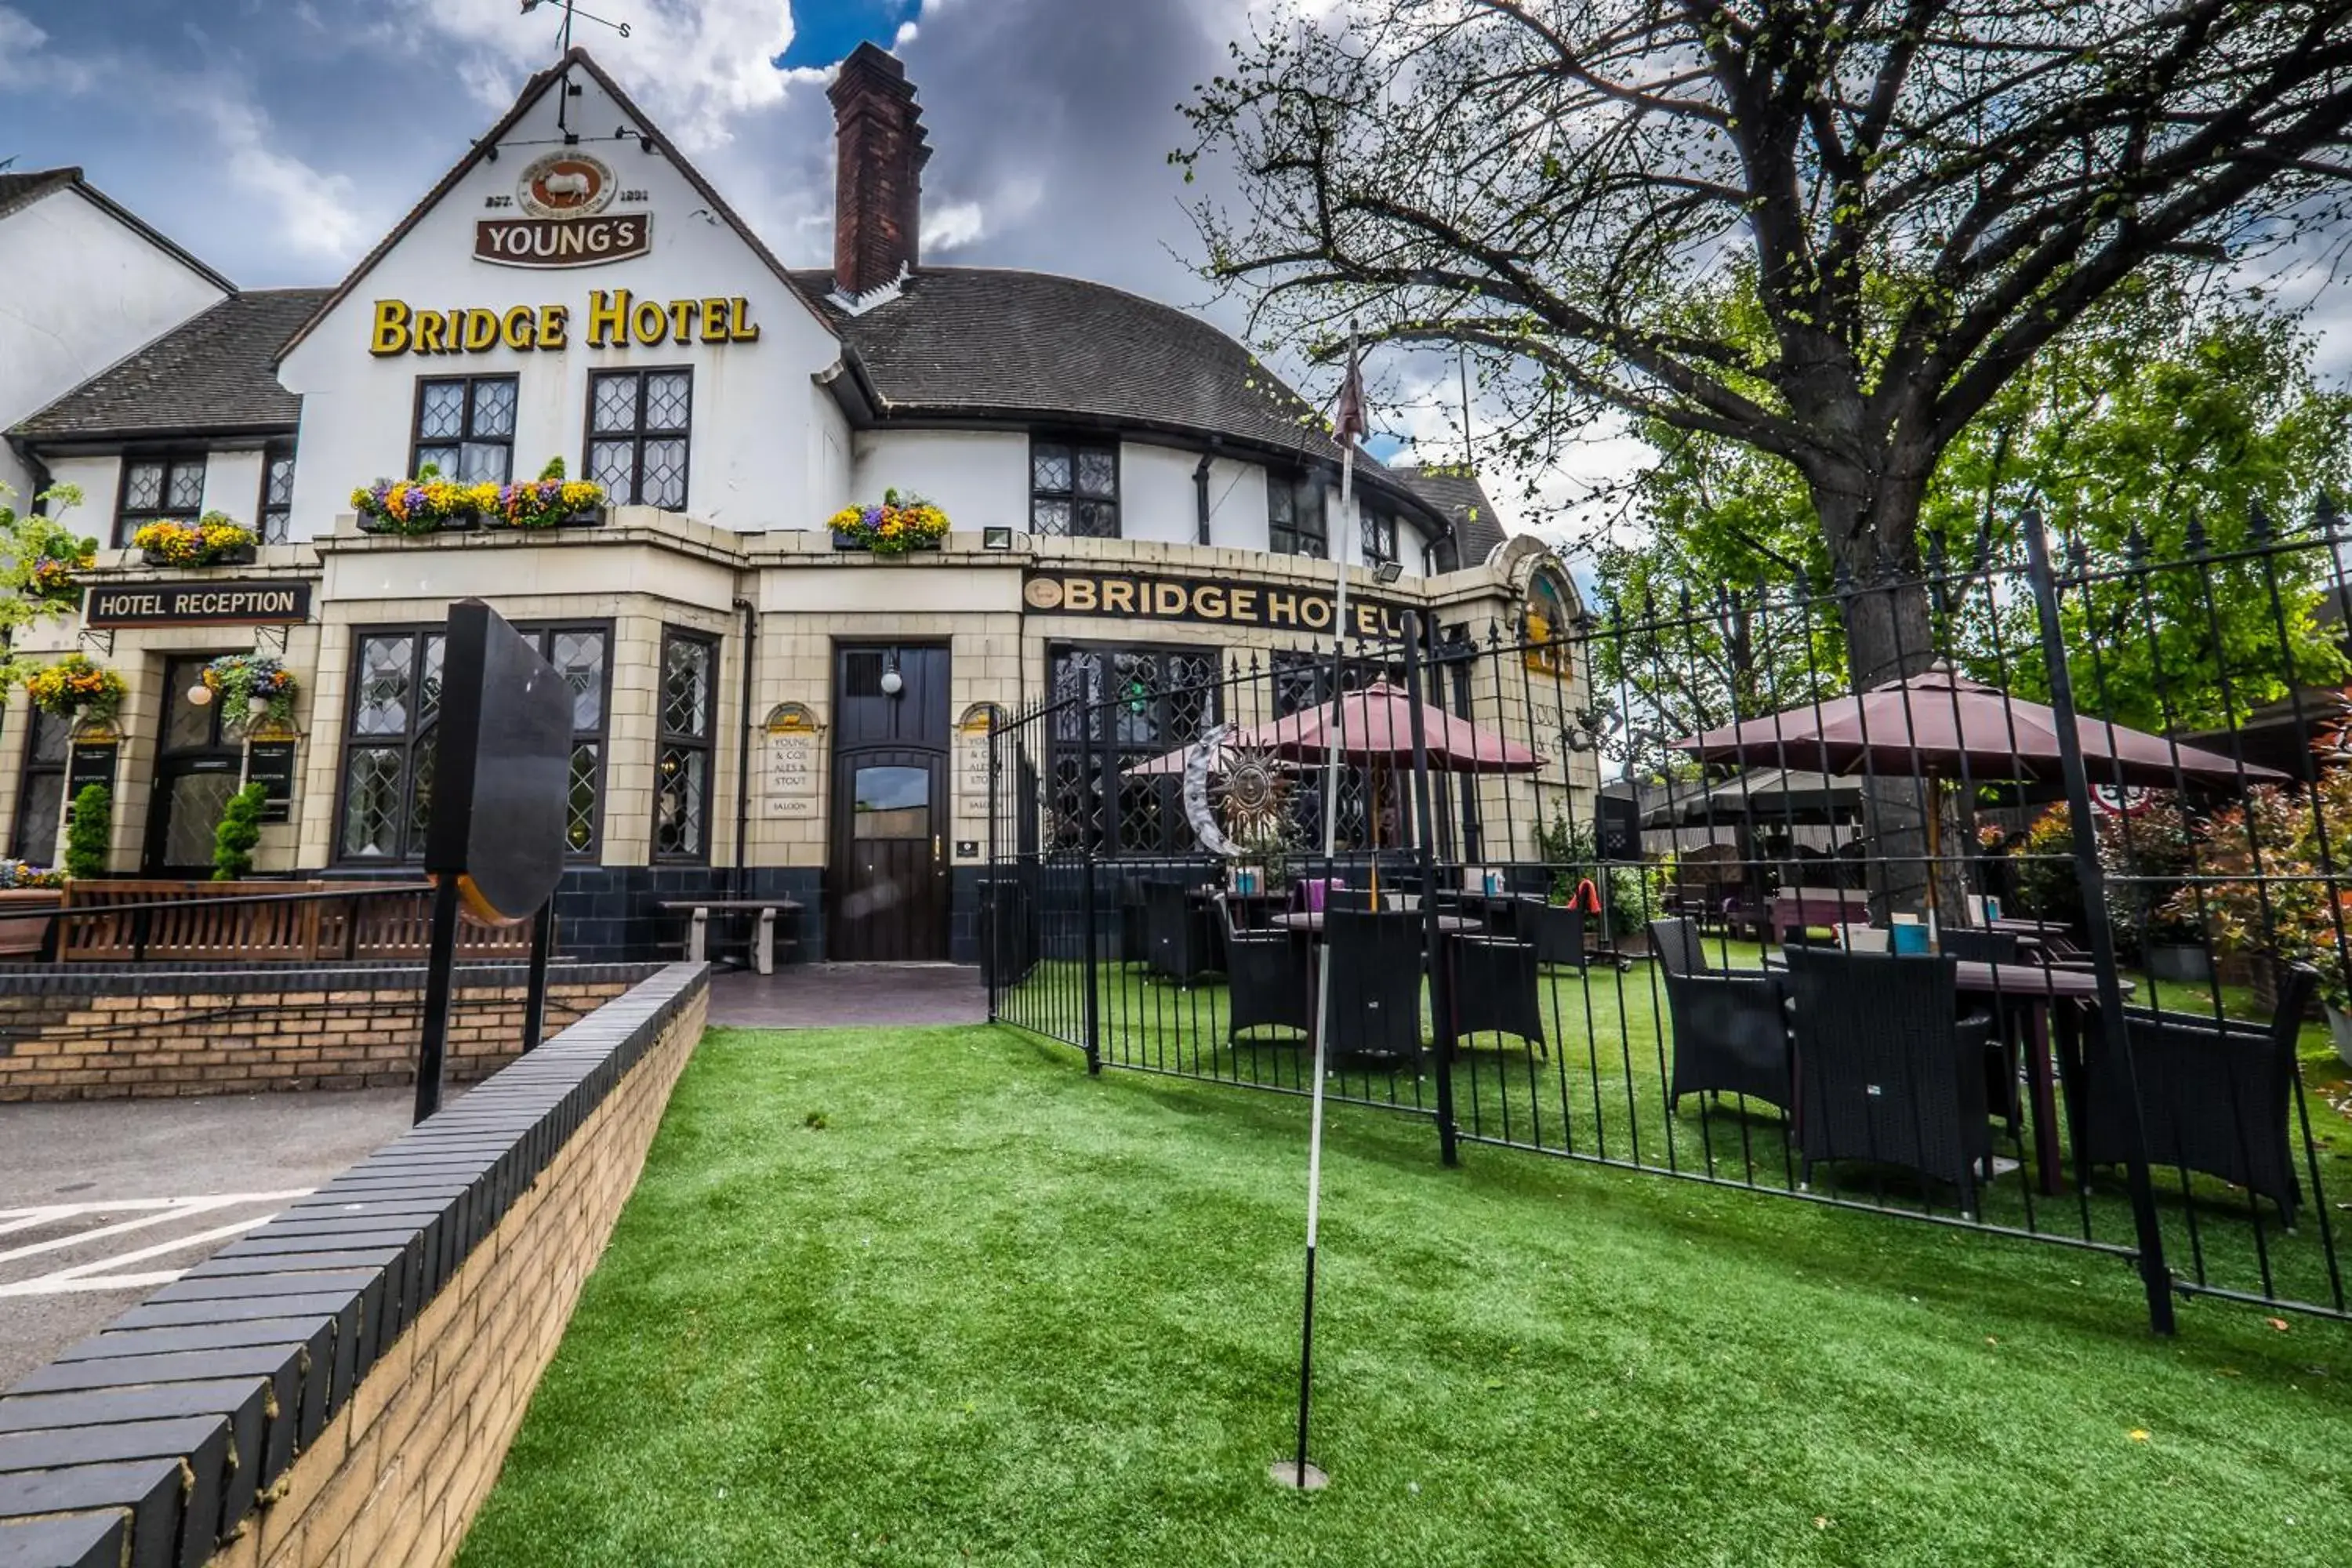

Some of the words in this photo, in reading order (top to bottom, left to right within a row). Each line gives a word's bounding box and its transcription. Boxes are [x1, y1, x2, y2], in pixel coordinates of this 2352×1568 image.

[488, 220, 635, 256] YOUNG'S
[369, 299, 568, 357] BRIDGE
[586, 289, 759, 348] HOTEL
[100, 595, 165, 615] HOTEL
[175, 591, 294, 614] RECEPTION
[1063, 578, 1258, 622] BRIDGE
